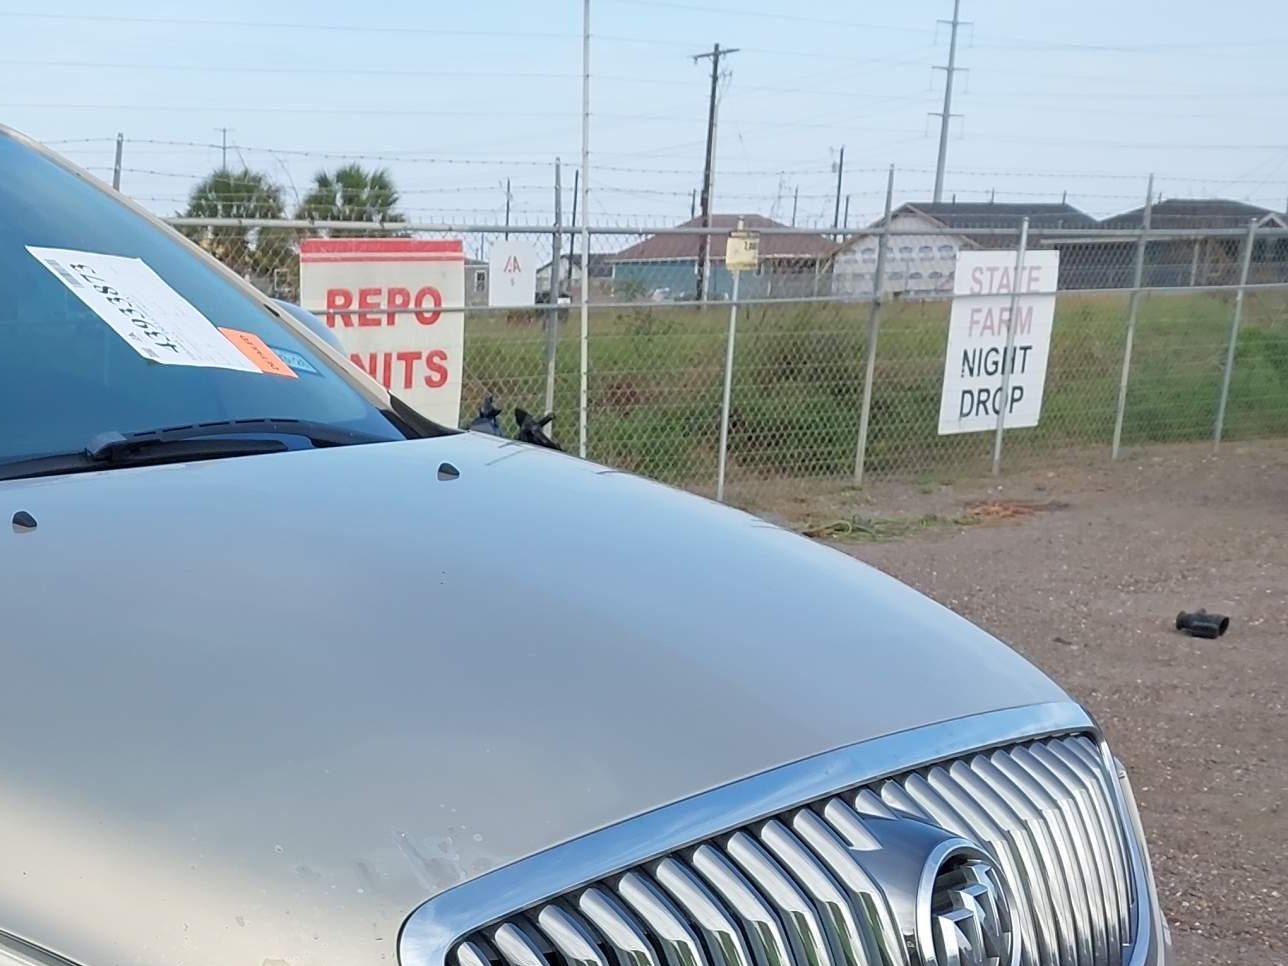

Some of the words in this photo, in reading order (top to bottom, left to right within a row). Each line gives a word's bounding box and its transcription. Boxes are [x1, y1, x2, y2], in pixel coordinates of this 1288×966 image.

[69, 263, 180, 353] 43933873
[326, 286, 442, 328] REPO
[350, 349, 449, 390] NITS
